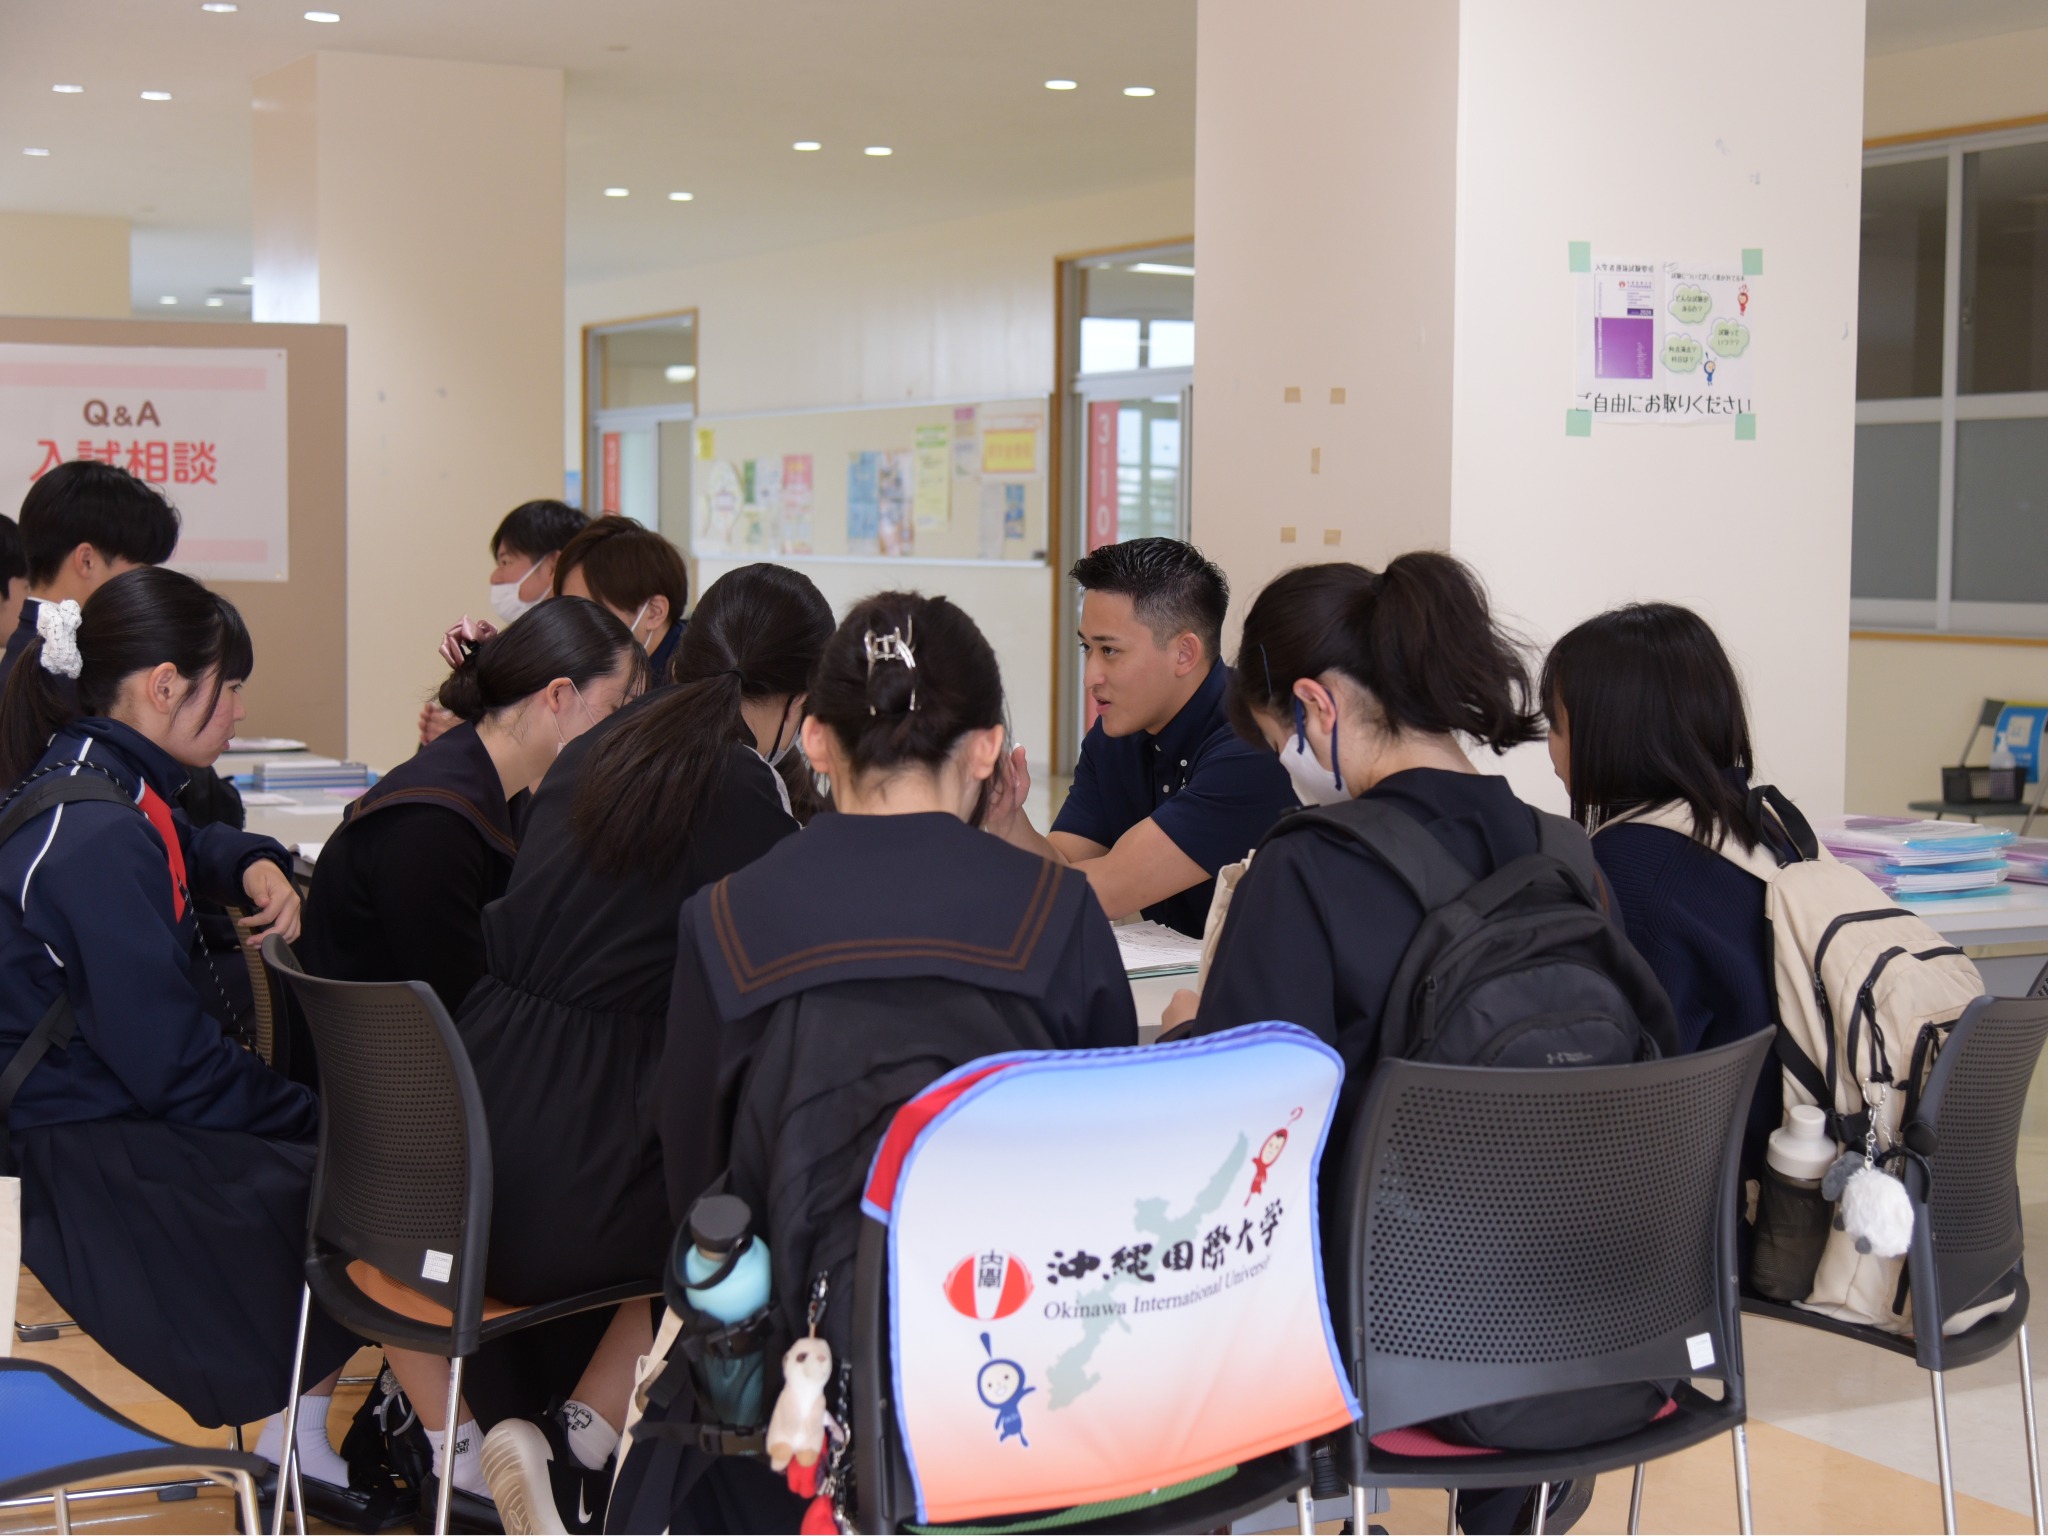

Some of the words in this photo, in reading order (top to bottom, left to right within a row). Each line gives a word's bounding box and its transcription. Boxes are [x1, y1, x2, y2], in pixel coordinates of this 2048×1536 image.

[83, 399, 161, 427] Q&A
[1576, 392, 1751, 415] ご自由にお取りください
[30, 440, 217, 485] 入試相談
[1047, 1198, 1283, 1284] 沖縄国際大学
[1044, 1300, 1127, 1320] Okinawa
[1133, 1274, 1223, 1314] International
